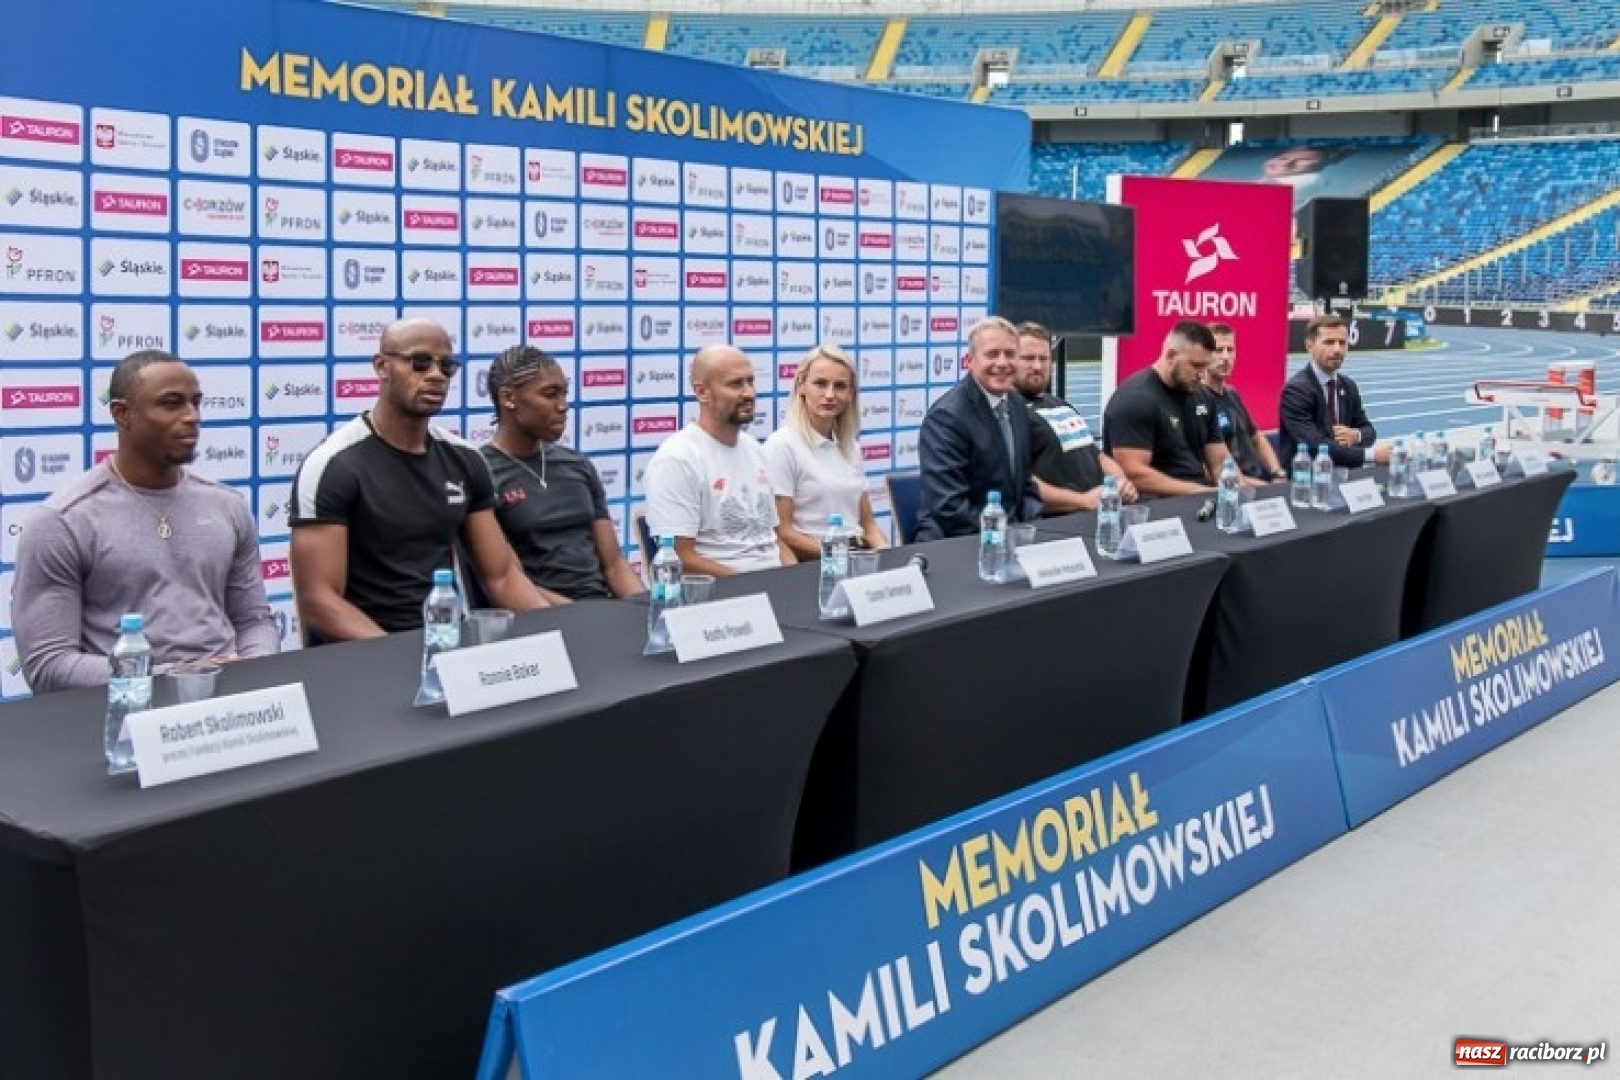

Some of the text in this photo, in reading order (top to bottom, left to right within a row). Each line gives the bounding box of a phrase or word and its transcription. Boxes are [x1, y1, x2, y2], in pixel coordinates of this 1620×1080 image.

[241, 46, 864, 156] MEMORIAŁ KAMILI SKOLIMOWSKIEJ
[26, 122, 74, 140] TAURON
[281, 217, 321, 230] PFRON
[27, 268, 76, 282] PFRON
[202, 264, 244, 277] TAURON
[1152, 290, 1257, 317] TAURON
[1424, 305, 1436, 323] 0
[1464, 306, 1470, 325] 1
[1501, 308, 1513, 326] 2
[1538, 309, 1549, 328] 3
[1574, 312, 1586, 330] 4
[118, 335, 164, 349] PFRON
[281, 326, 320, 338] TAURON
[1349, 318, 1396, 345] 6 7
[28, 391, 74, 404] TAURON
[1450, 608, 1549, 684] MEMORIAŁ
[1391, 627, 1605, 767] KAMILI SKOLIMOWSKIEJ
[160, 702, 286, 744] Robert Skolimowski
[919, 772, 1158, 929] MEMORIAŁ
[734, 785, 1275, 1080] KAMILI SKOLIMOWSKIEJ
